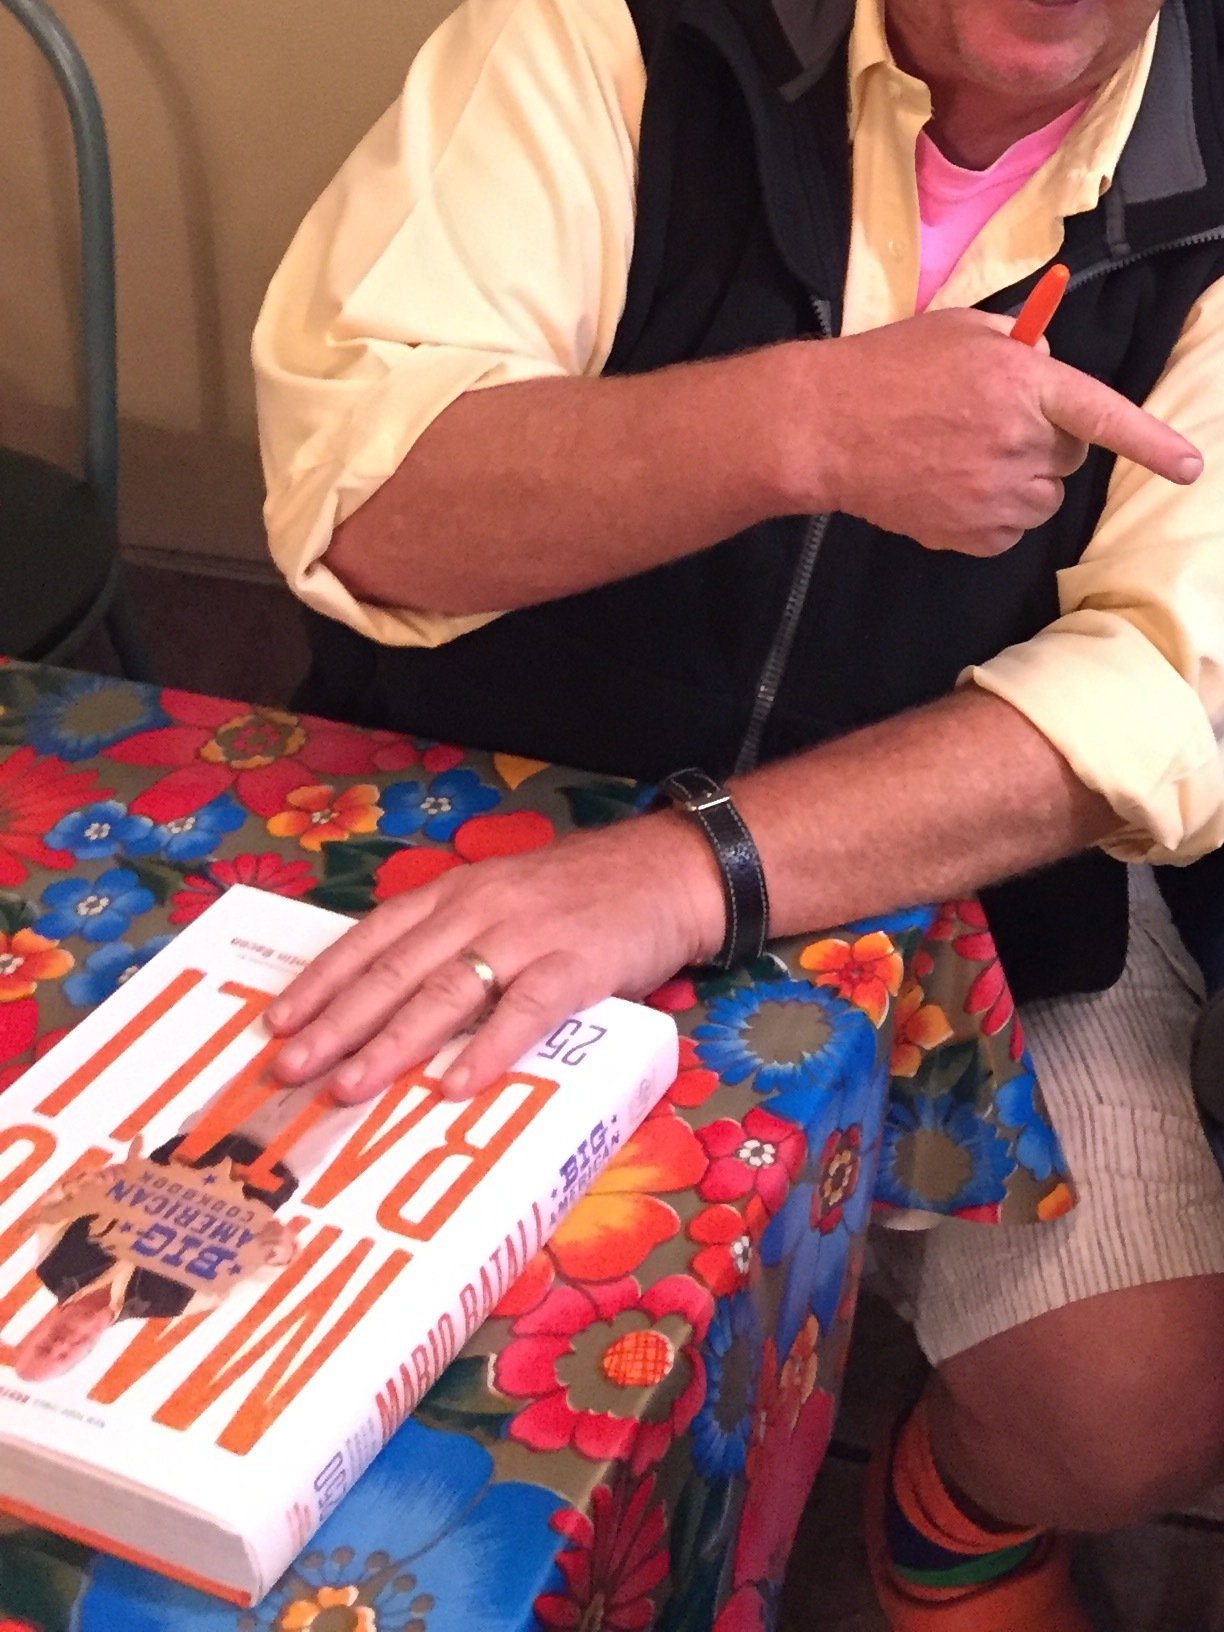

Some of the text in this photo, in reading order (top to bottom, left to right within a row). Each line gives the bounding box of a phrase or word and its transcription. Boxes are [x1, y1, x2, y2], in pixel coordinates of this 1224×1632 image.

[558, 1119, 606, 1194] BIG
[104, 1178, 255, 1249] AMERICAN
[134, 1170, 255, 1224] COOKBOOK
[131, 1223, 238, 1281] BIG
[375, 1200, 543, 1441] MARIO BATALI
